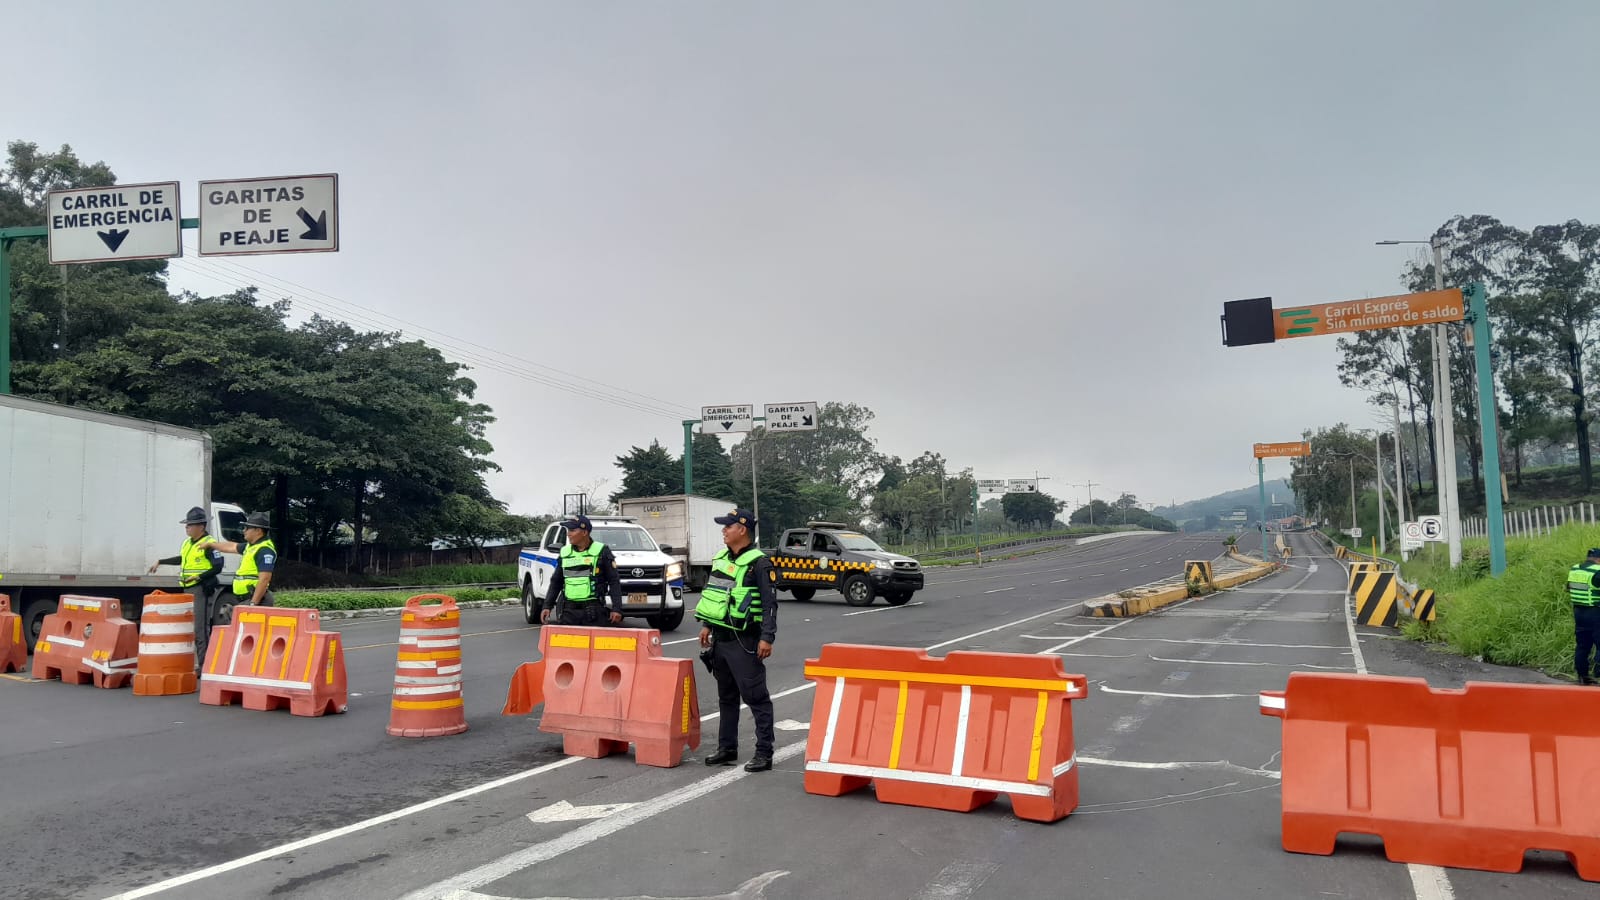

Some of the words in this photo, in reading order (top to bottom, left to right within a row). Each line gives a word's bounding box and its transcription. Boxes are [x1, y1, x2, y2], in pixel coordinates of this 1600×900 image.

[62, 192, 128, 211] CARRIL
[140, 190, 163, 205] DE
[208, 186, 305, 206] GARITAS
[53, 207, 173, 229] EMERGENCIA
[243, 209, 271, 223] DE
[219, 229, 289, 246] PEAJE
[1326, 304, 1361, 318] Carril
[1364, 298, 1409, 317] Exprés
[1326, 317, 1346, 330] Sin
[1350, 312, 1399, 327] mínimo
[1403, 310, 1419, 321] de
[1422, 305, 1458, 319] saldo
[703, 413, 751, 422] EMERGENCIA
[768, 406, 805, 414] GARITAS
[781, 571, 836, 582] TRANSITO
